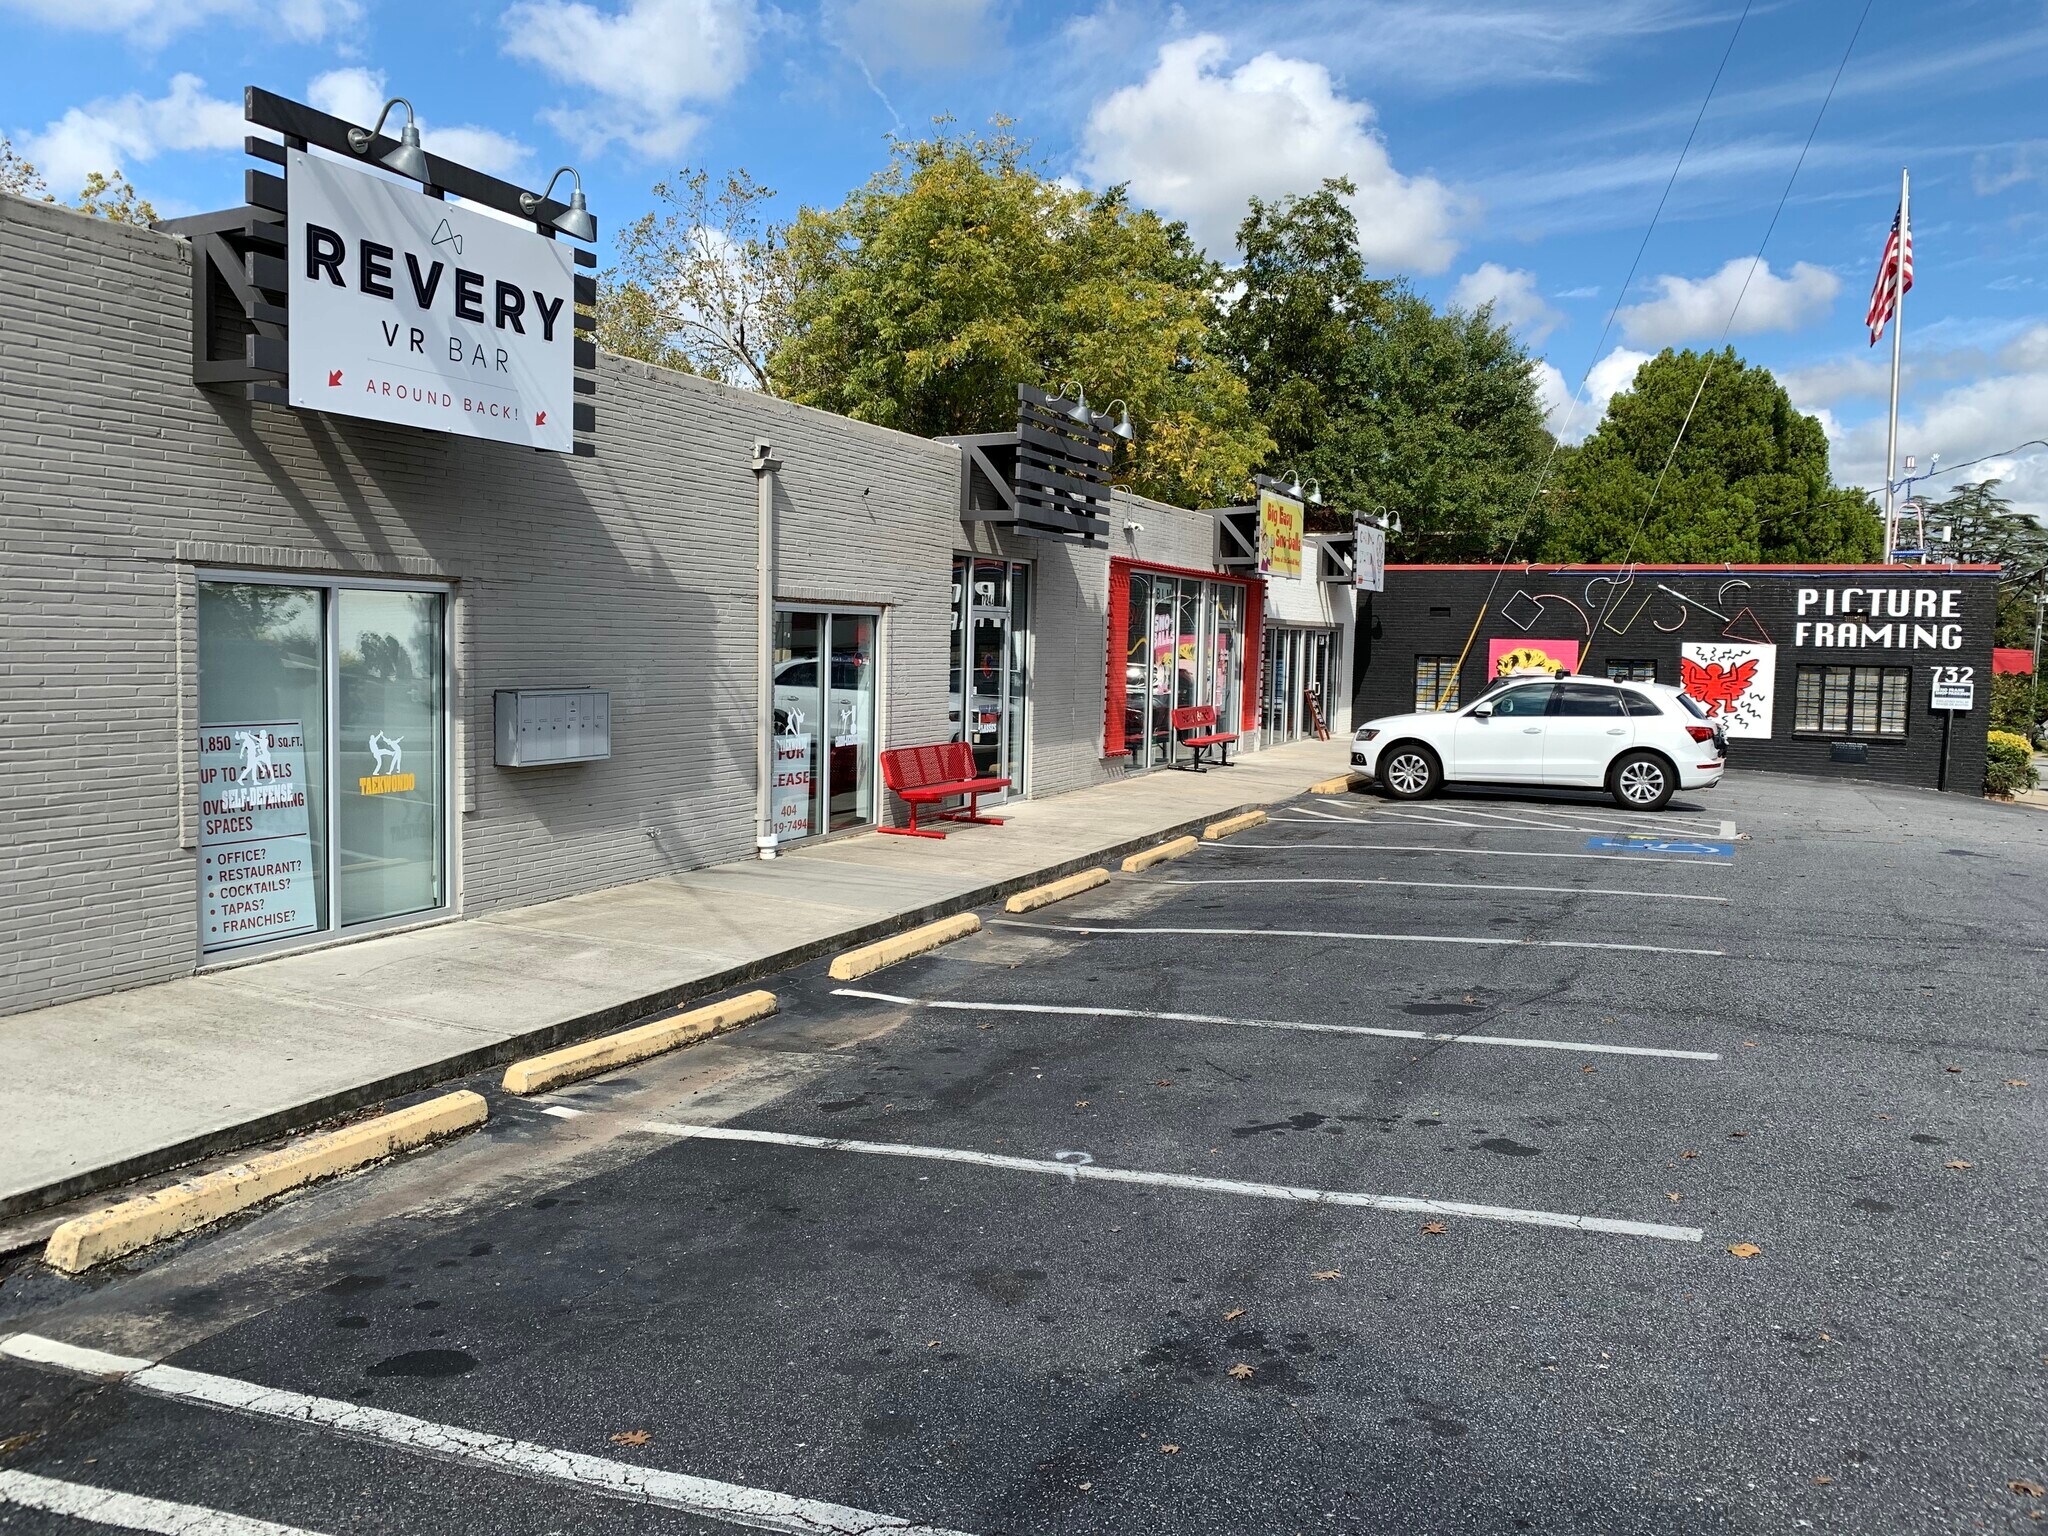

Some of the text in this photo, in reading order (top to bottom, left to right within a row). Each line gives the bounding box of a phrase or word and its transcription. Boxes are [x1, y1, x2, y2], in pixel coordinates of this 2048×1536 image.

[306, 222, 564, 342] REVERY
[382, 320, 508, 374] VR BAR
[366, 379, 518, 421] AROUND BACK!
[1267, 502, 1293, 531] Big Easy
[1797, 588, 1962, 618] PICTURE
[1795, 622, 1963, 650] FRAMING
[1930, 666, 1974, 684] 732
[200, 735, 231, 754] 1,850
[278, 736, 304, 748] SQ.FT.
[200, 768, 218, 784] UP
[221, 766, 237, 782] TO
[359, 773, 416, 796] TAEKWONDO
[773, 771, 809, 787] EASE
[221, 783, 294, 811] SELF-DEFENSE
[781, 805, 797, 817] 404
[206, 816, 254, 836] SPACES
[217, 848, 267, 866] OFFICE?
[219, 859, 303, 883] RESTAURANT?
[220, 878, 292, 900] COCKTAILS?
[221, 898, 266, 917] TAPAS?
[223, 909, 297, 934] FRANCHISE?
